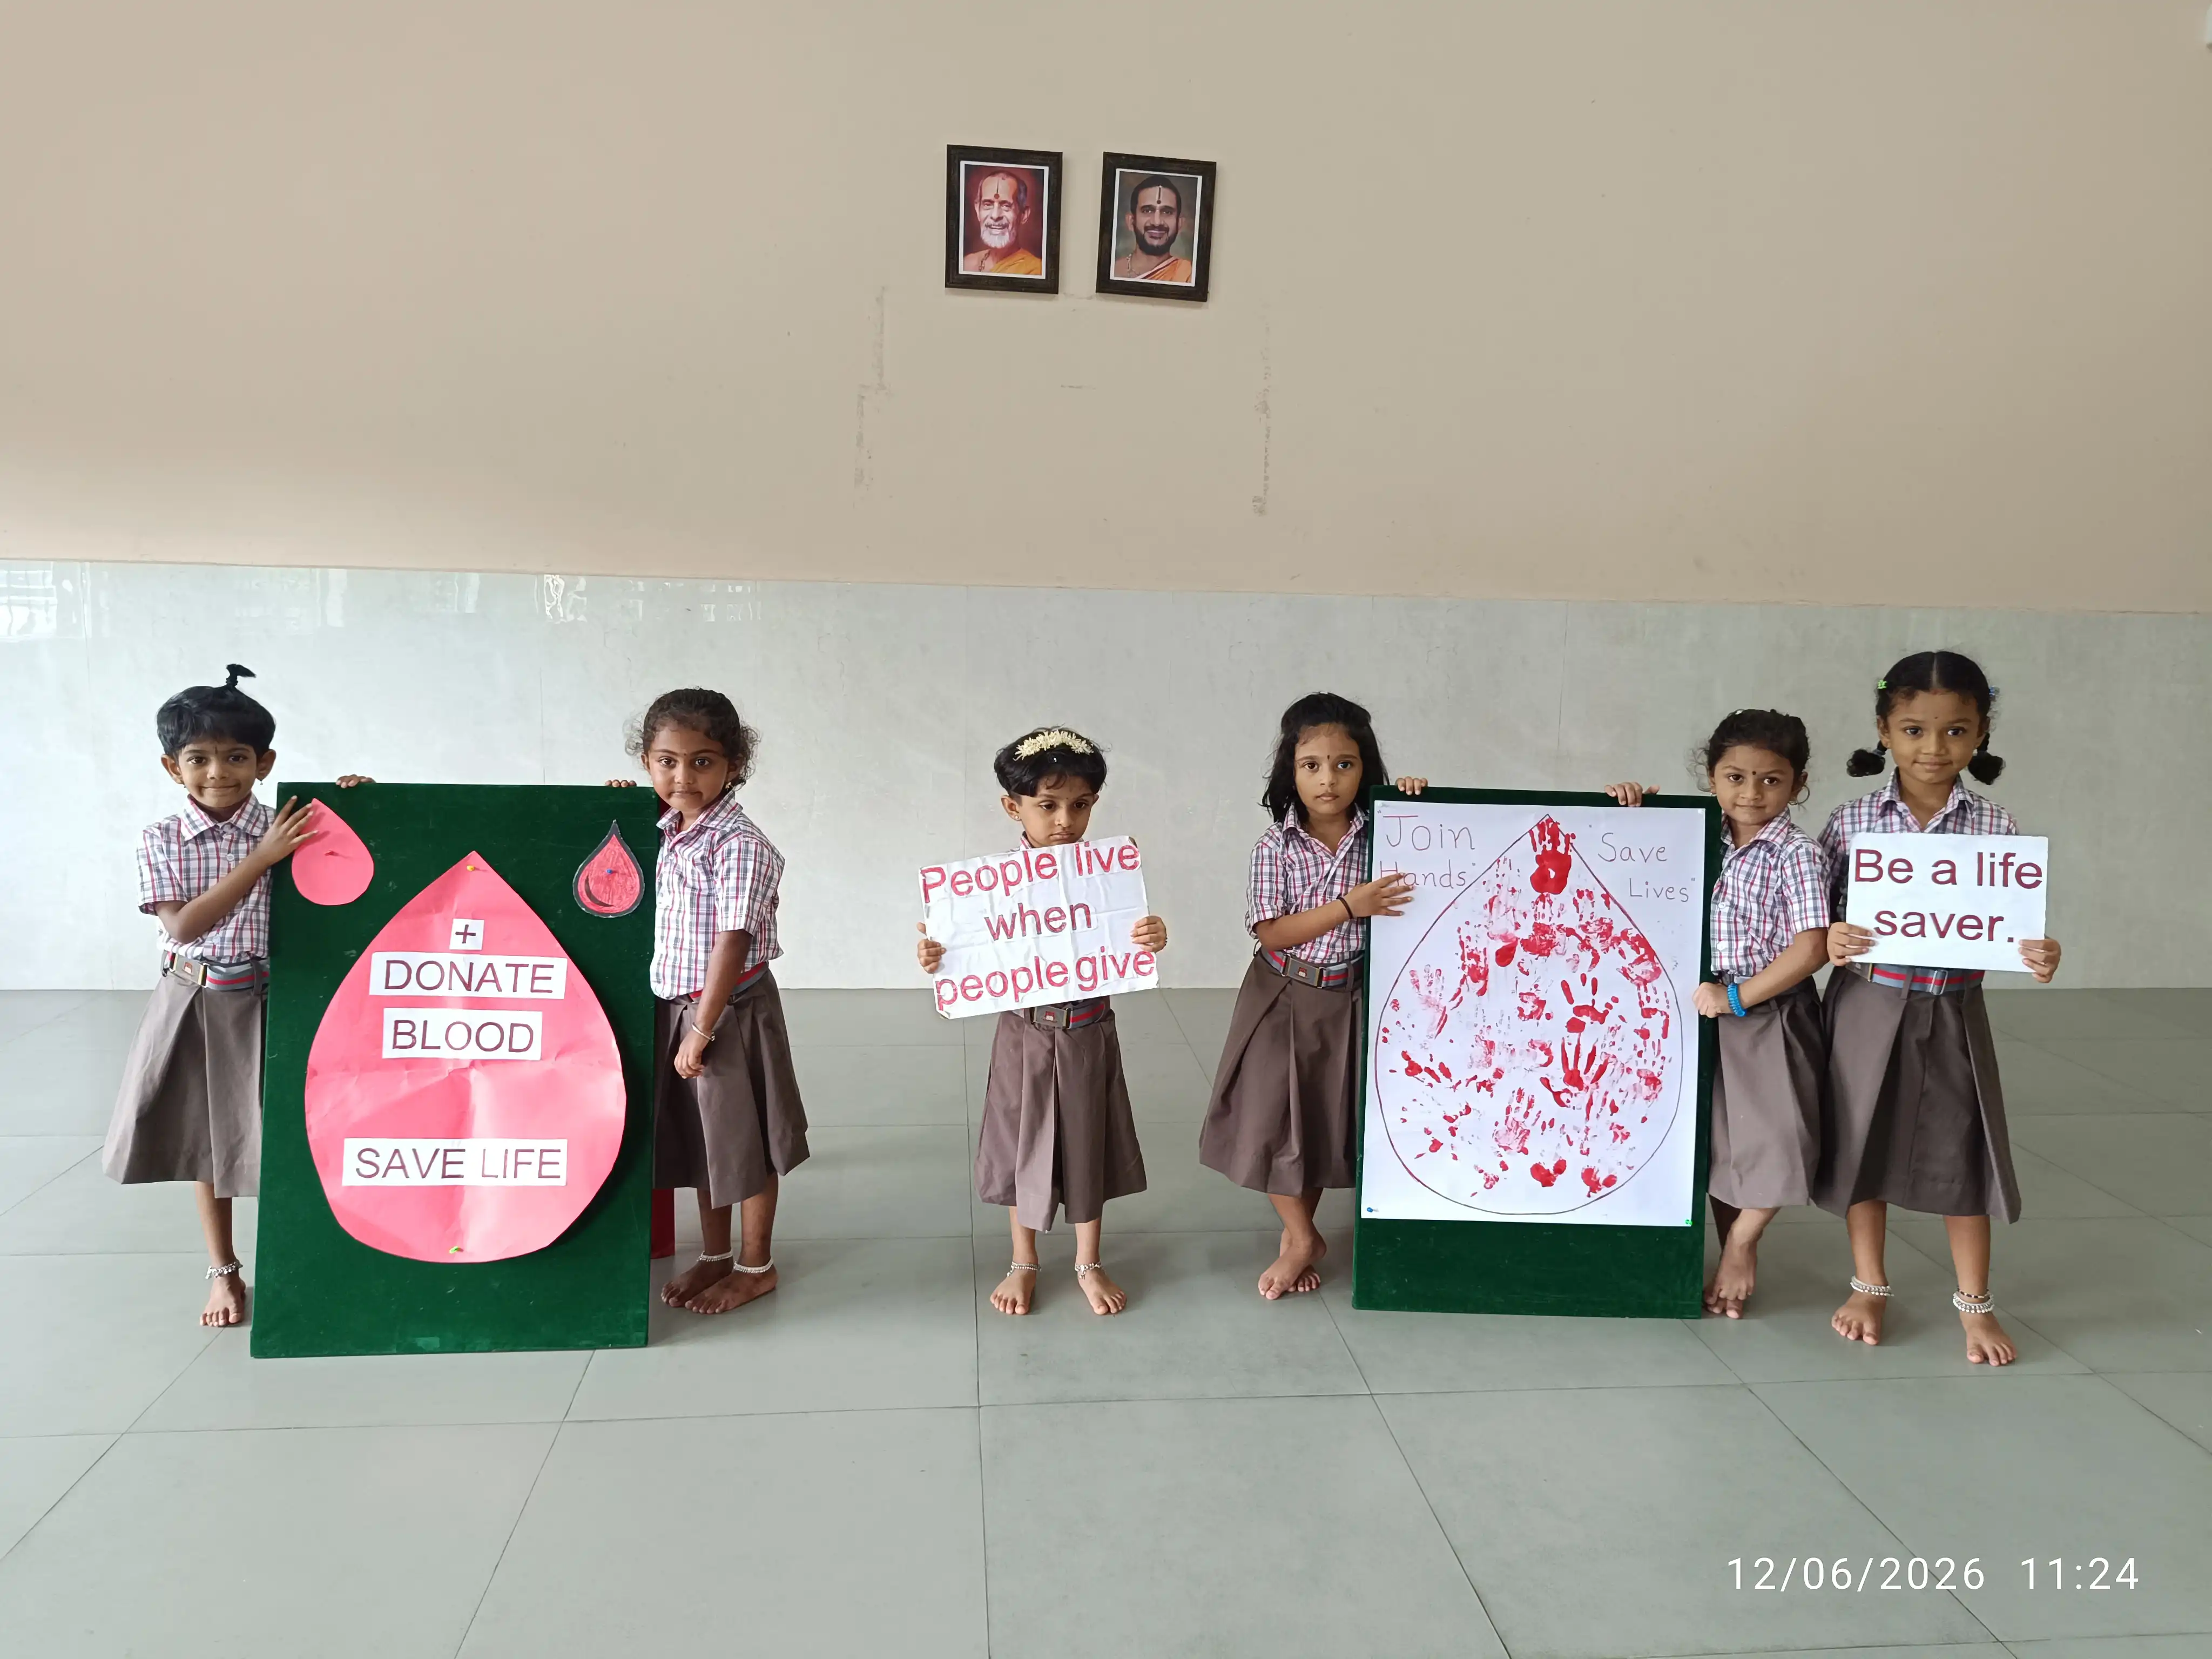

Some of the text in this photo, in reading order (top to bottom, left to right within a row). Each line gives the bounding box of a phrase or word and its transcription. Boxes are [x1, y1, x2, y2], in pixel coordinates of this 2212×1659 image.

[921, 841, 1141, 903] People live
[1854, 848, 2043, 889] Be a life
[984, 902, 1092, 941] when
[1873, 910, 2014, 943] saver.
[385, 960, 555, 994] DONATE
[935, 946, 1156, 1011] people give
[392, 1020, 534, 1053] BLOOD
[355, 1148, 561, 1179] SAVE LIFE
